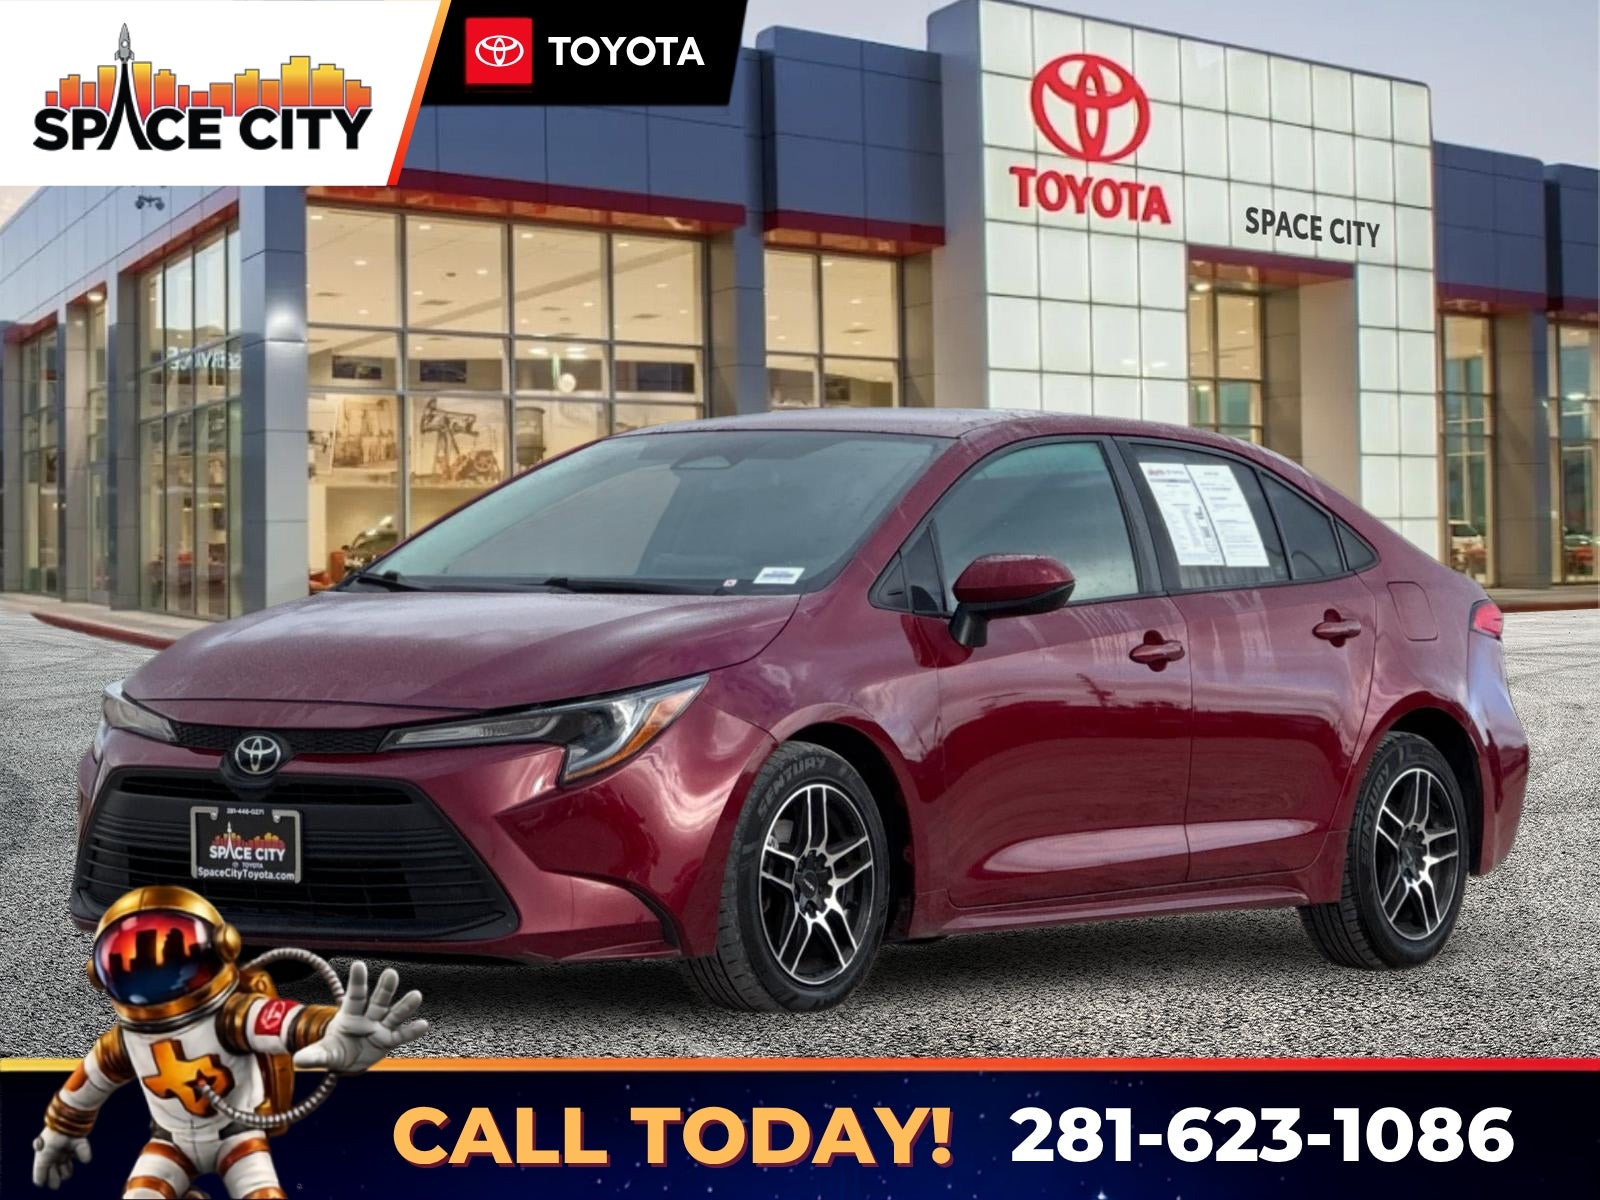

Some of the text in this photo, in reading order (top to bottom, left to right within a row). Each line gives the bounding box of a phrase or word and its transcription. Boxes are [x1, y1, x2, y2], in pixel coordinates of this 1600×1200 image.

[1009, 166, 1171, 224] TOYOTA
[1245, 206, 1381, 249] SPACE CITY
[757, 756, 827, 818] SENTURY
[198, 867, 295, 880] SpaceCityToyota.com
[208, 844, 286, 862] SPACE CITY
